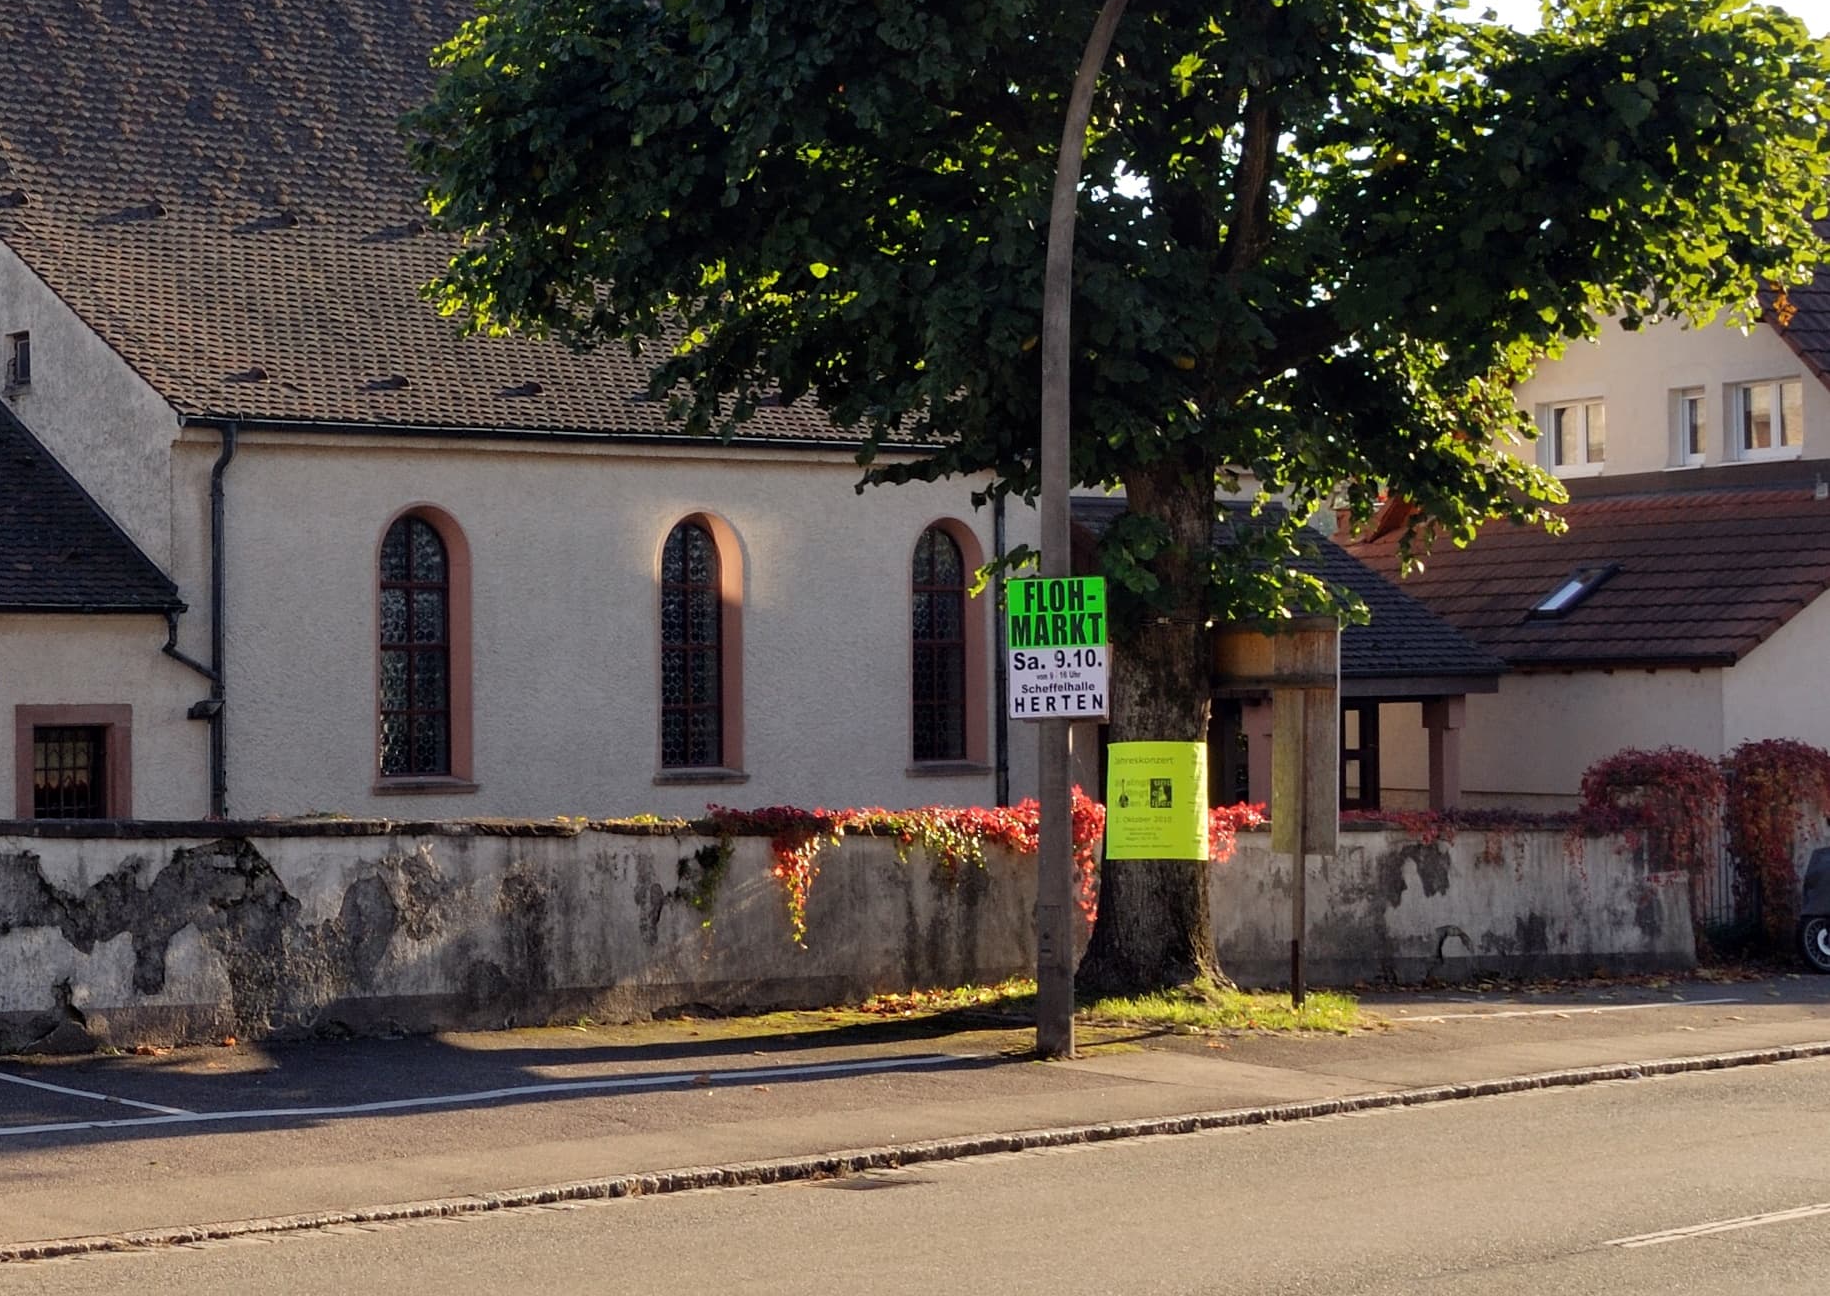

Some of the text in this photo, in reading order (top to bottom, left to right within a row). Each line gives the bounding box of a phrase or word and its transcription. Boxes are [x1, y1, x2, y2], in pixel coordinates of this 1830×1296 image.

[1023, 579, 1097, 613] FLOH-
[1010, 612, 1103, 647] MARKT
[1013, 649, 1103, 671] Sa. 9.10.
[1069, 670, 1081, 679] Uhr
[1021, 681, 1096, 694] Scheffelhalle
[1014, 694, 1103, 713] HERTEN
